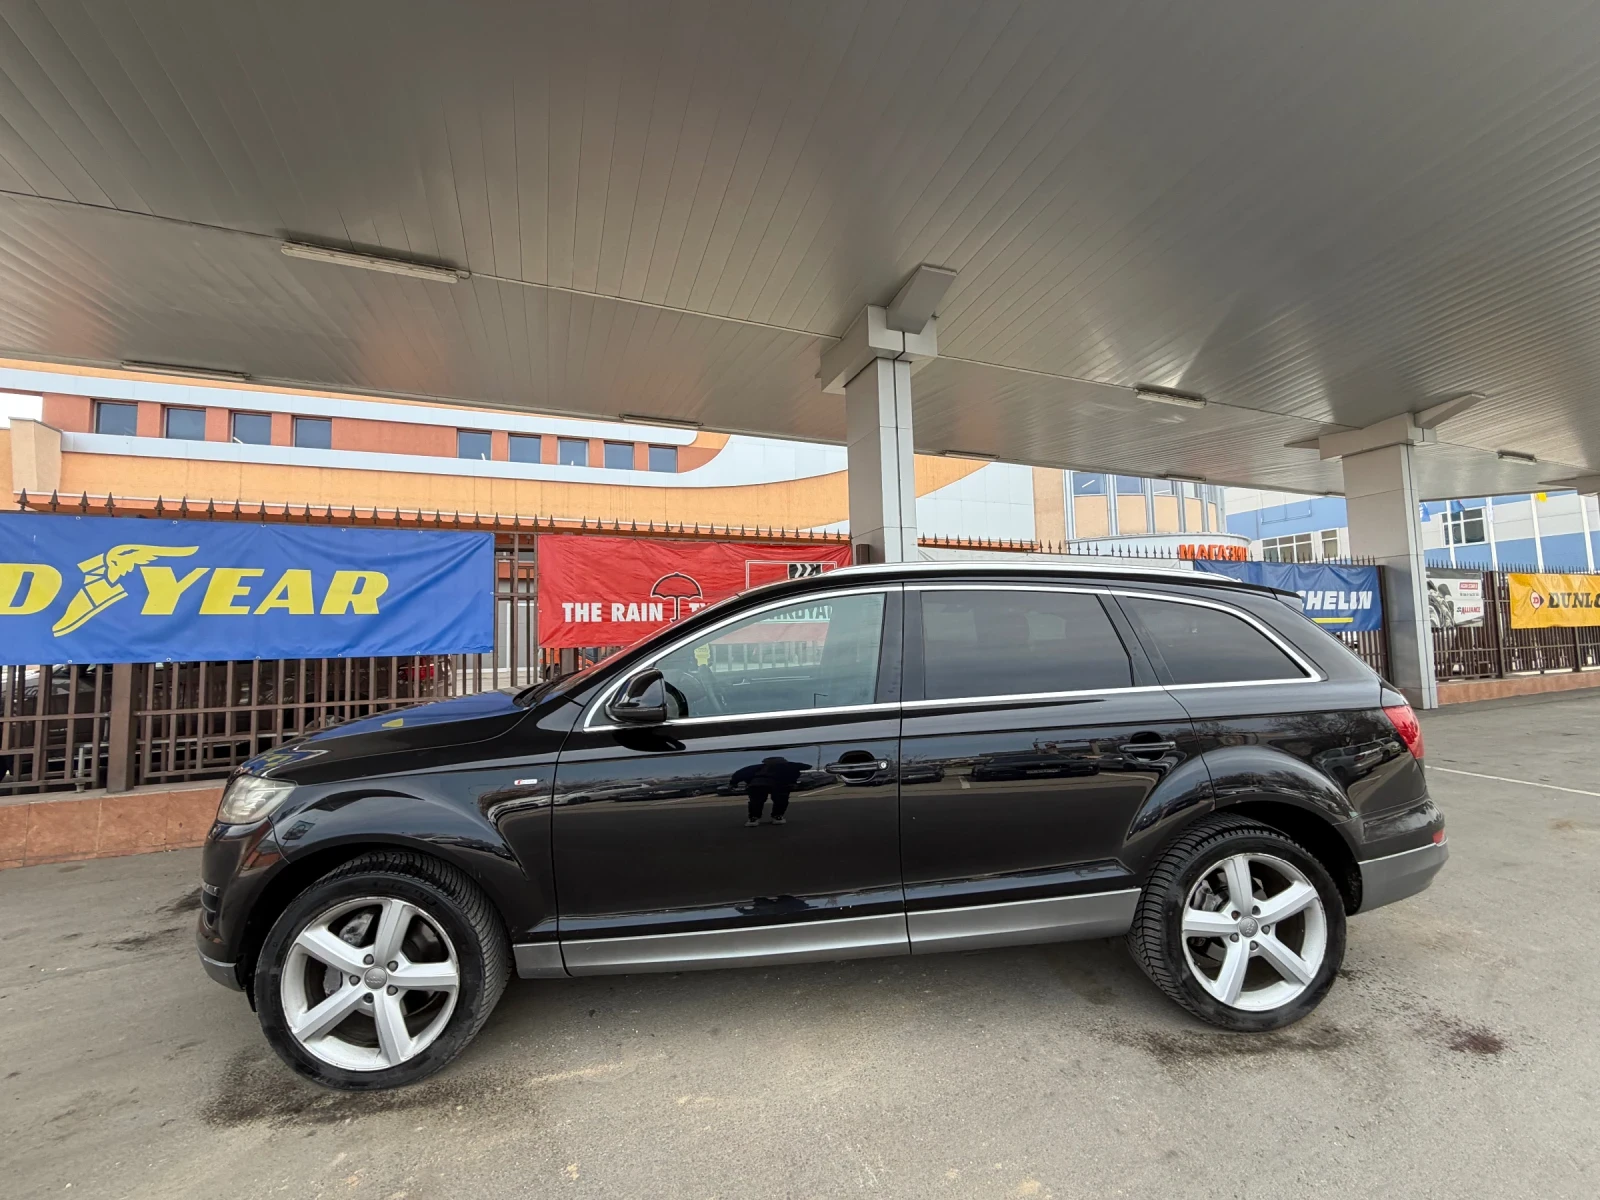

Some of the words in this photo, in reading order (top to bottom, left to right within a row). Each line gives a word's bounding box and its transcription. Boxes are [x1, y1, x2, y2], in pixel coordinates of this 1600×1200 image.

[562, 602, 602, 623] THE
[611, 602, 663, 622] RAIN
[1461, 606, 1481, 614] ALLIANCE
